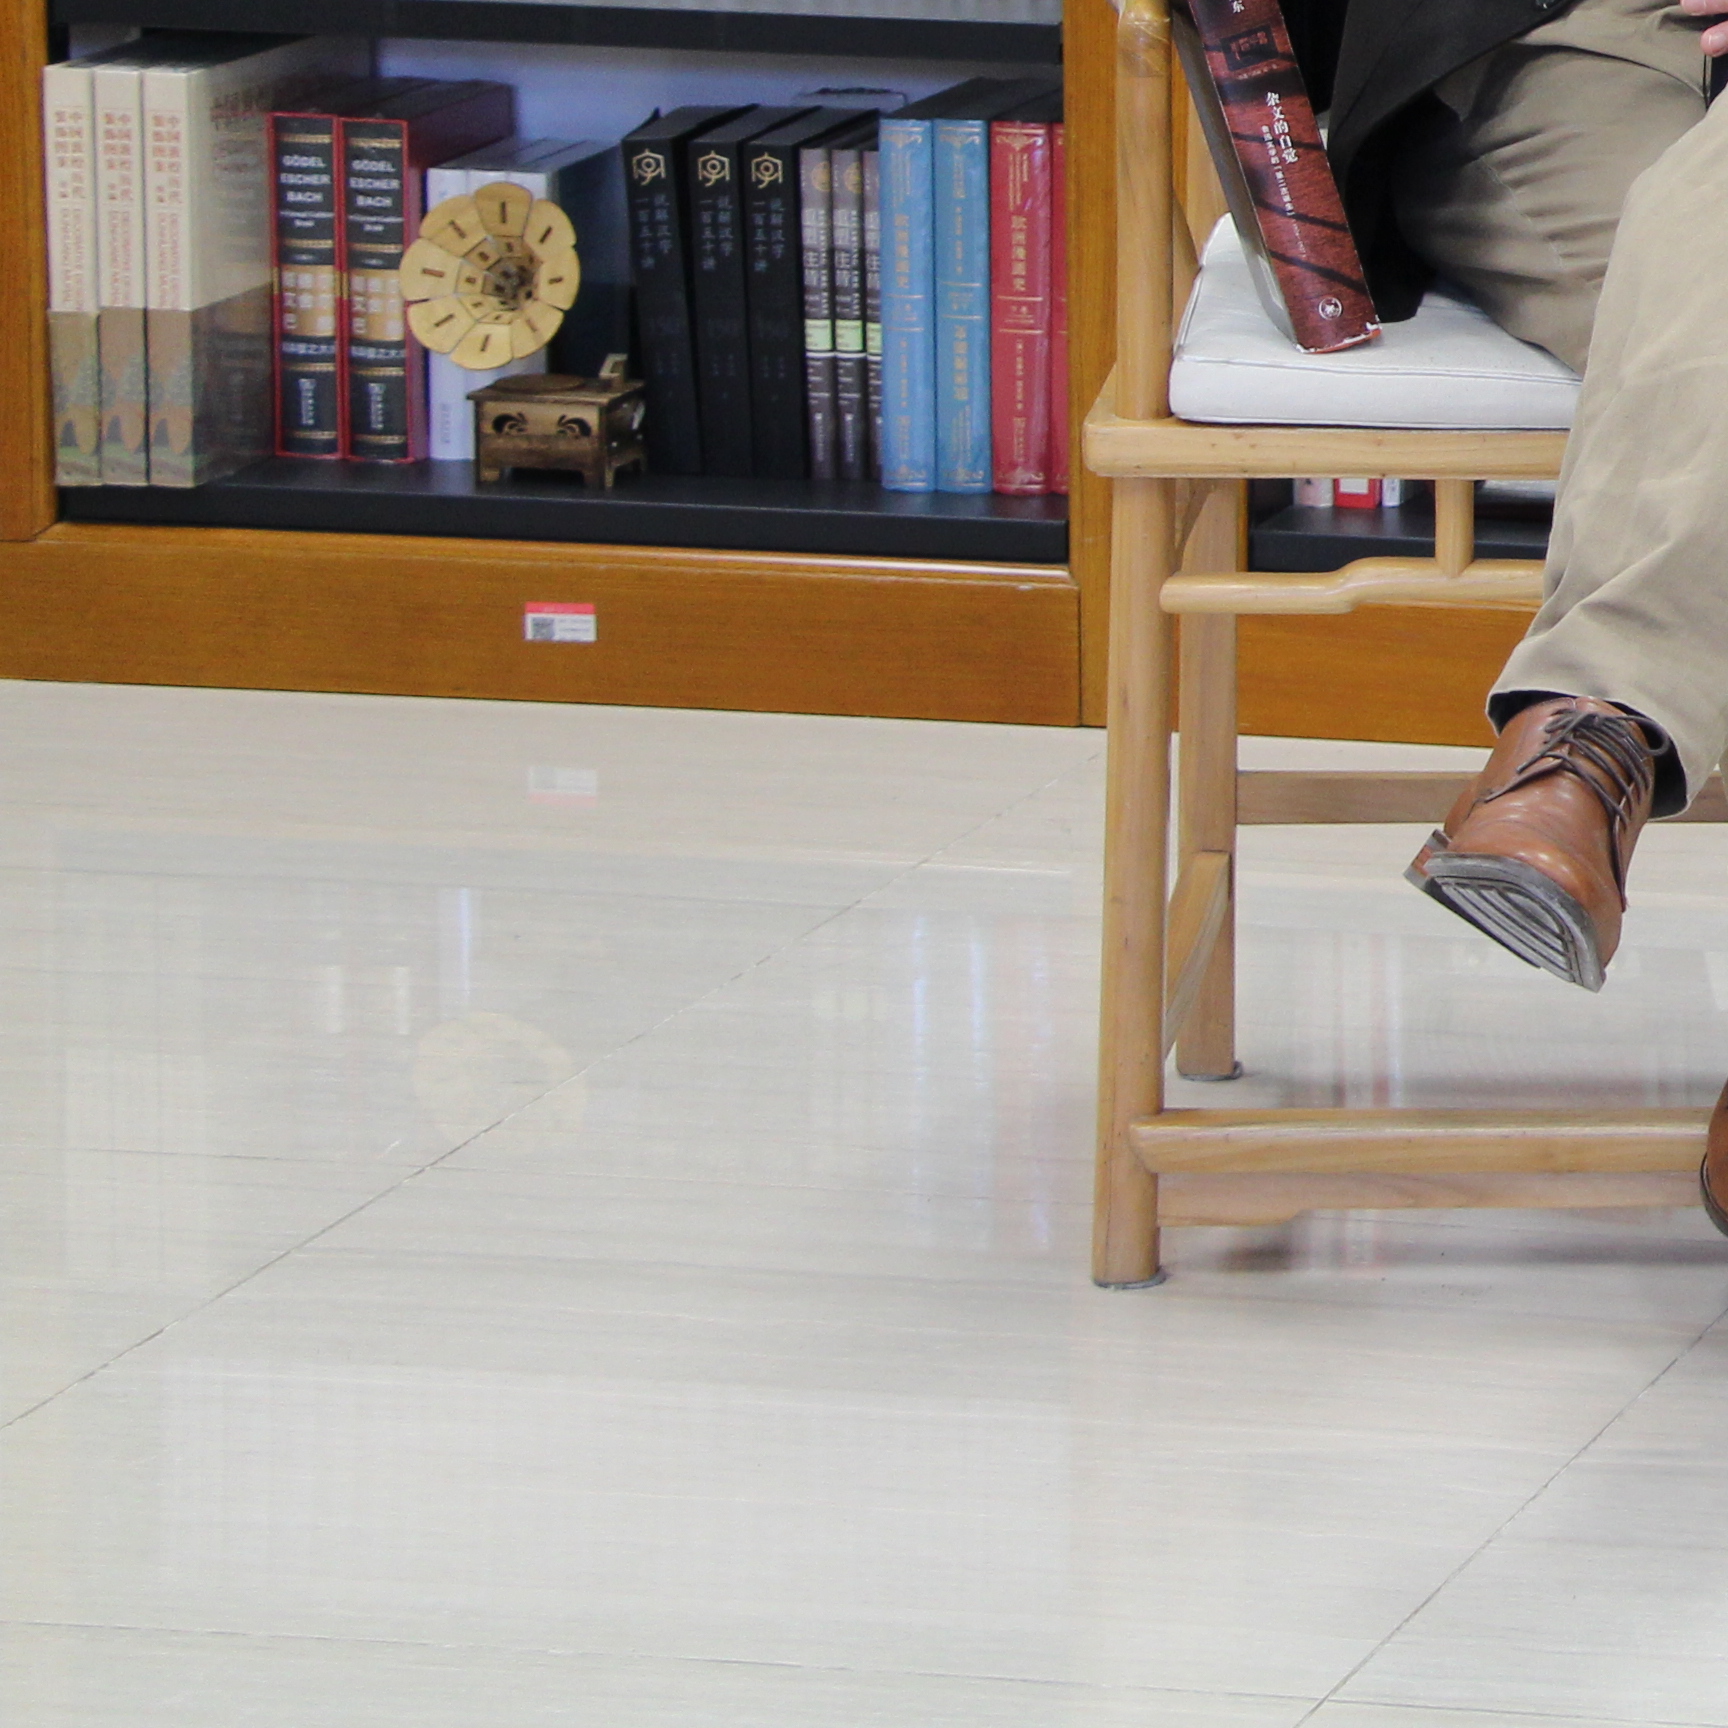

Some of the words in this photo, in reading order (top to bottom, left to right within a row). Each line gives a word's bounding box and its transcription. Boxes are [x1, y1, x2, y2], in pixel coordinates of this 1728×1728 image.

[1265, 90, 1299, 165] 杂文的自觉
